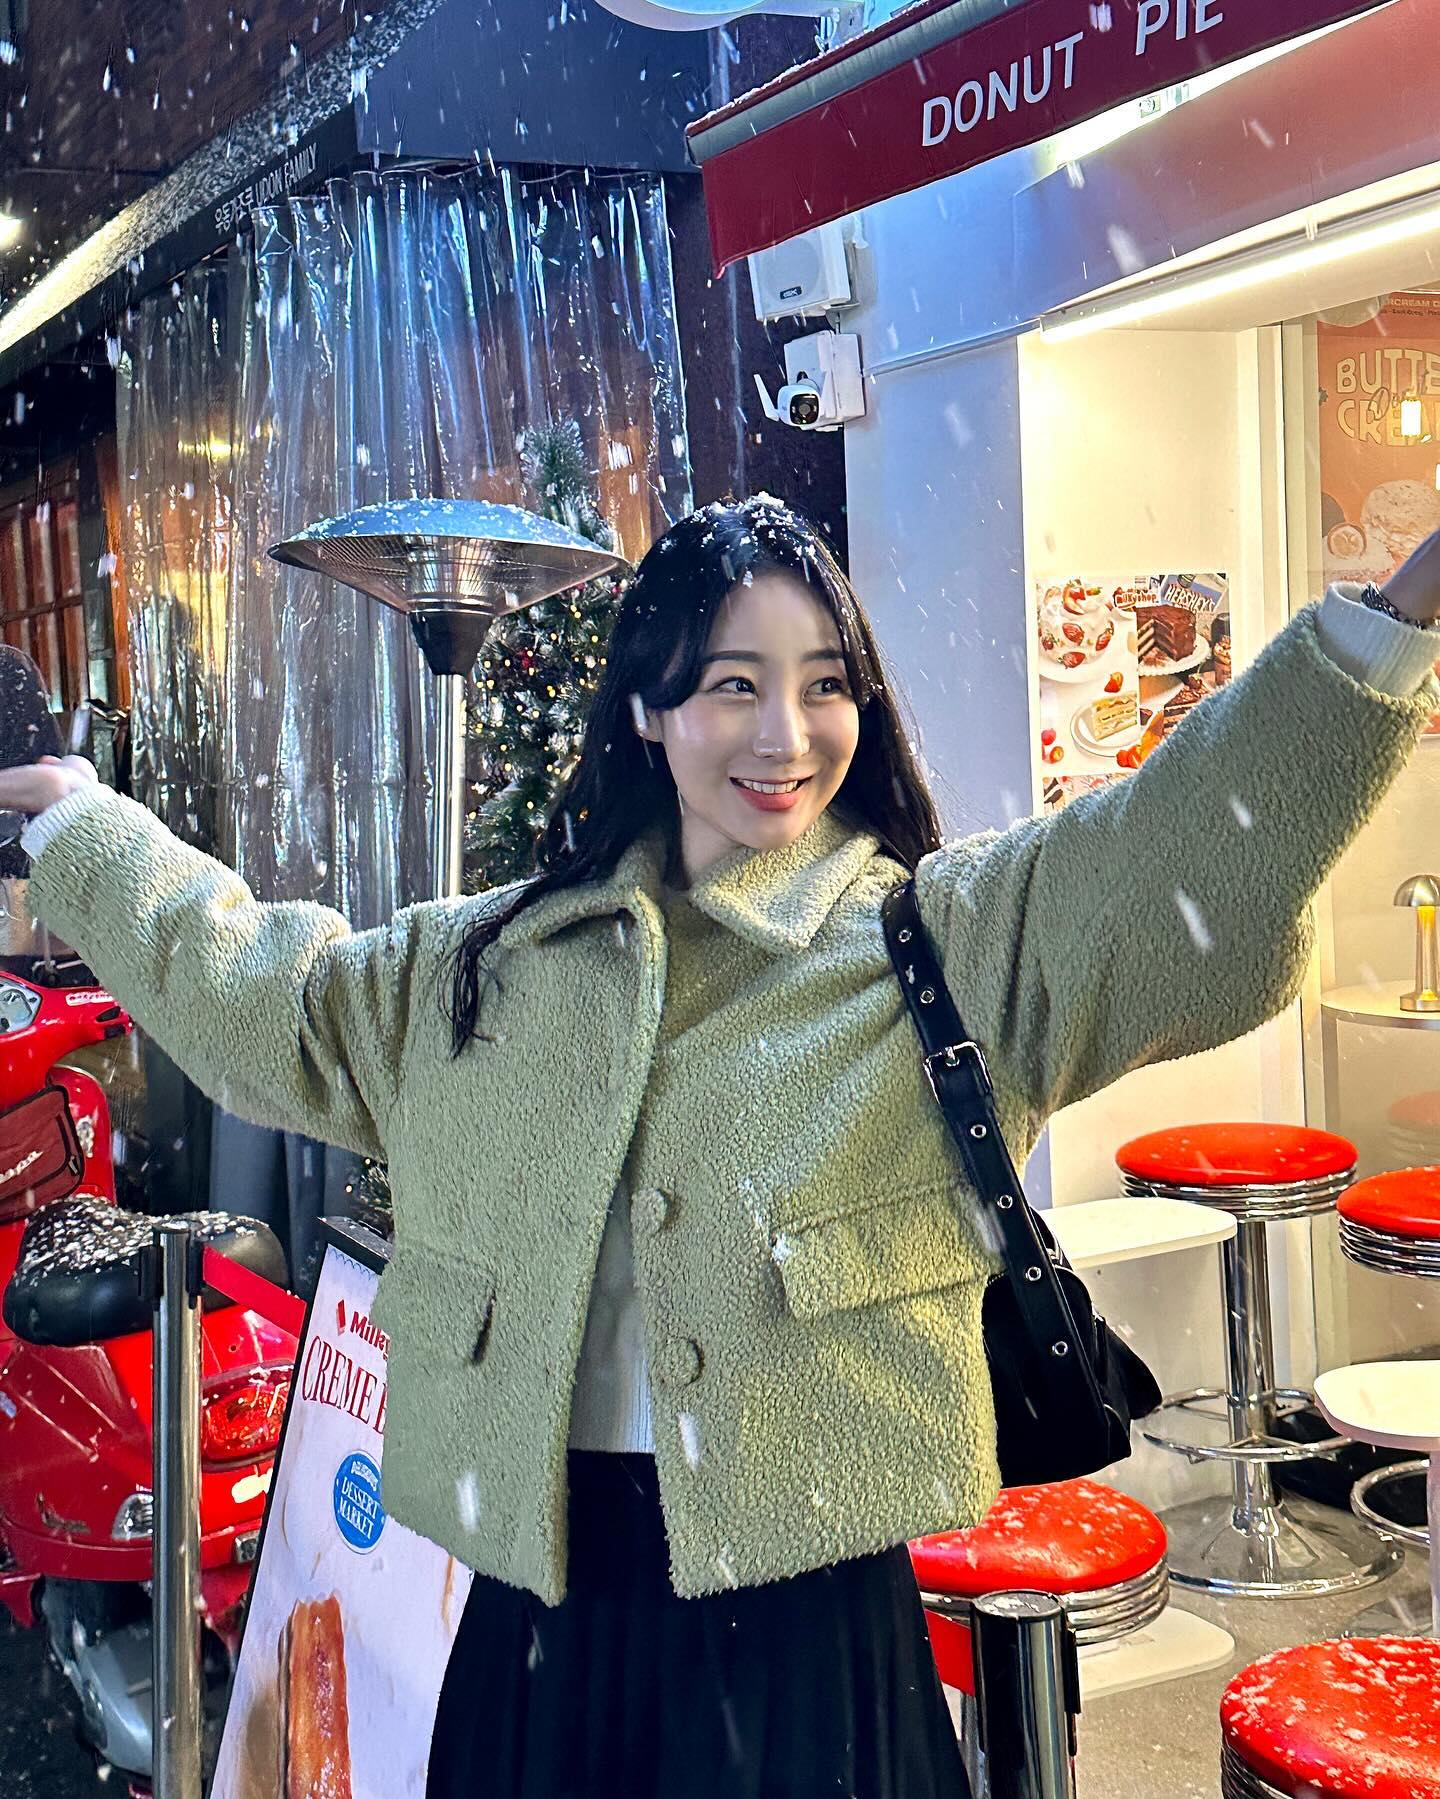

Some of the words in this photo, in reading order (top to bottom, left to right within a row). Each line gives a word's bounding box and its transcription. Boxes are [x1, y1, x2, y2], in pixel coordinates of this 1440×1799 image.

[921, 32, 1084, 147] DONUT
[1135, 0, 1224, 56] PIE
[302, 1335, 378, 1425] CREME
[339, 1496, 374, 1539] MARKET
[341, 1477, 380, 1519] DESSERT
